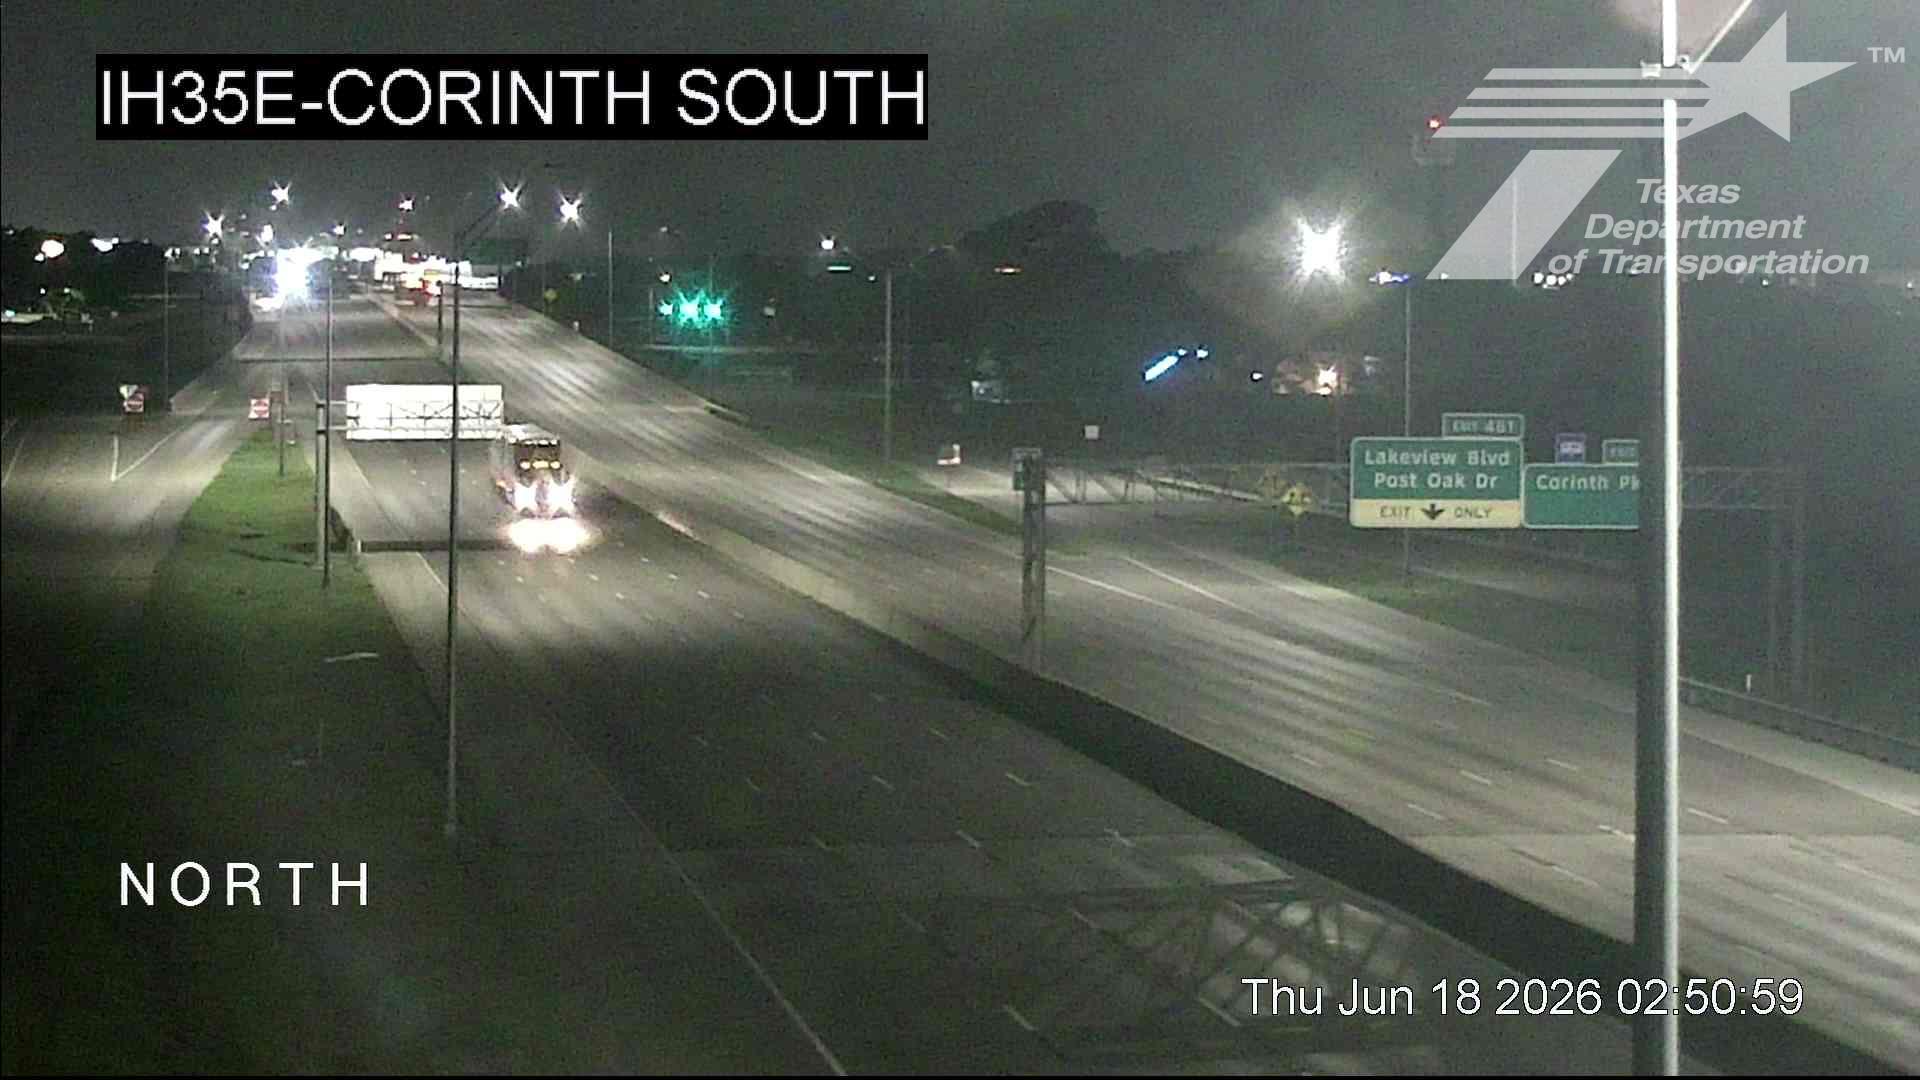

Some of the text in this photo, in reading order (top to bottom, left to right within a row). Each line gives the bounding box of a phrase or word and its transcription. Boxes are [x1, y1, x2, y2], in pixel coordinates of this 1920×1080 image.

[1364, 449, 1510, 465] Lakeview Blvd
[1374, 472, 1500, 489] Post Oak Dr
[1535, 474, 1608, 491] Corinth
[1380, 506, 1493, 518] EXIT ONLY
